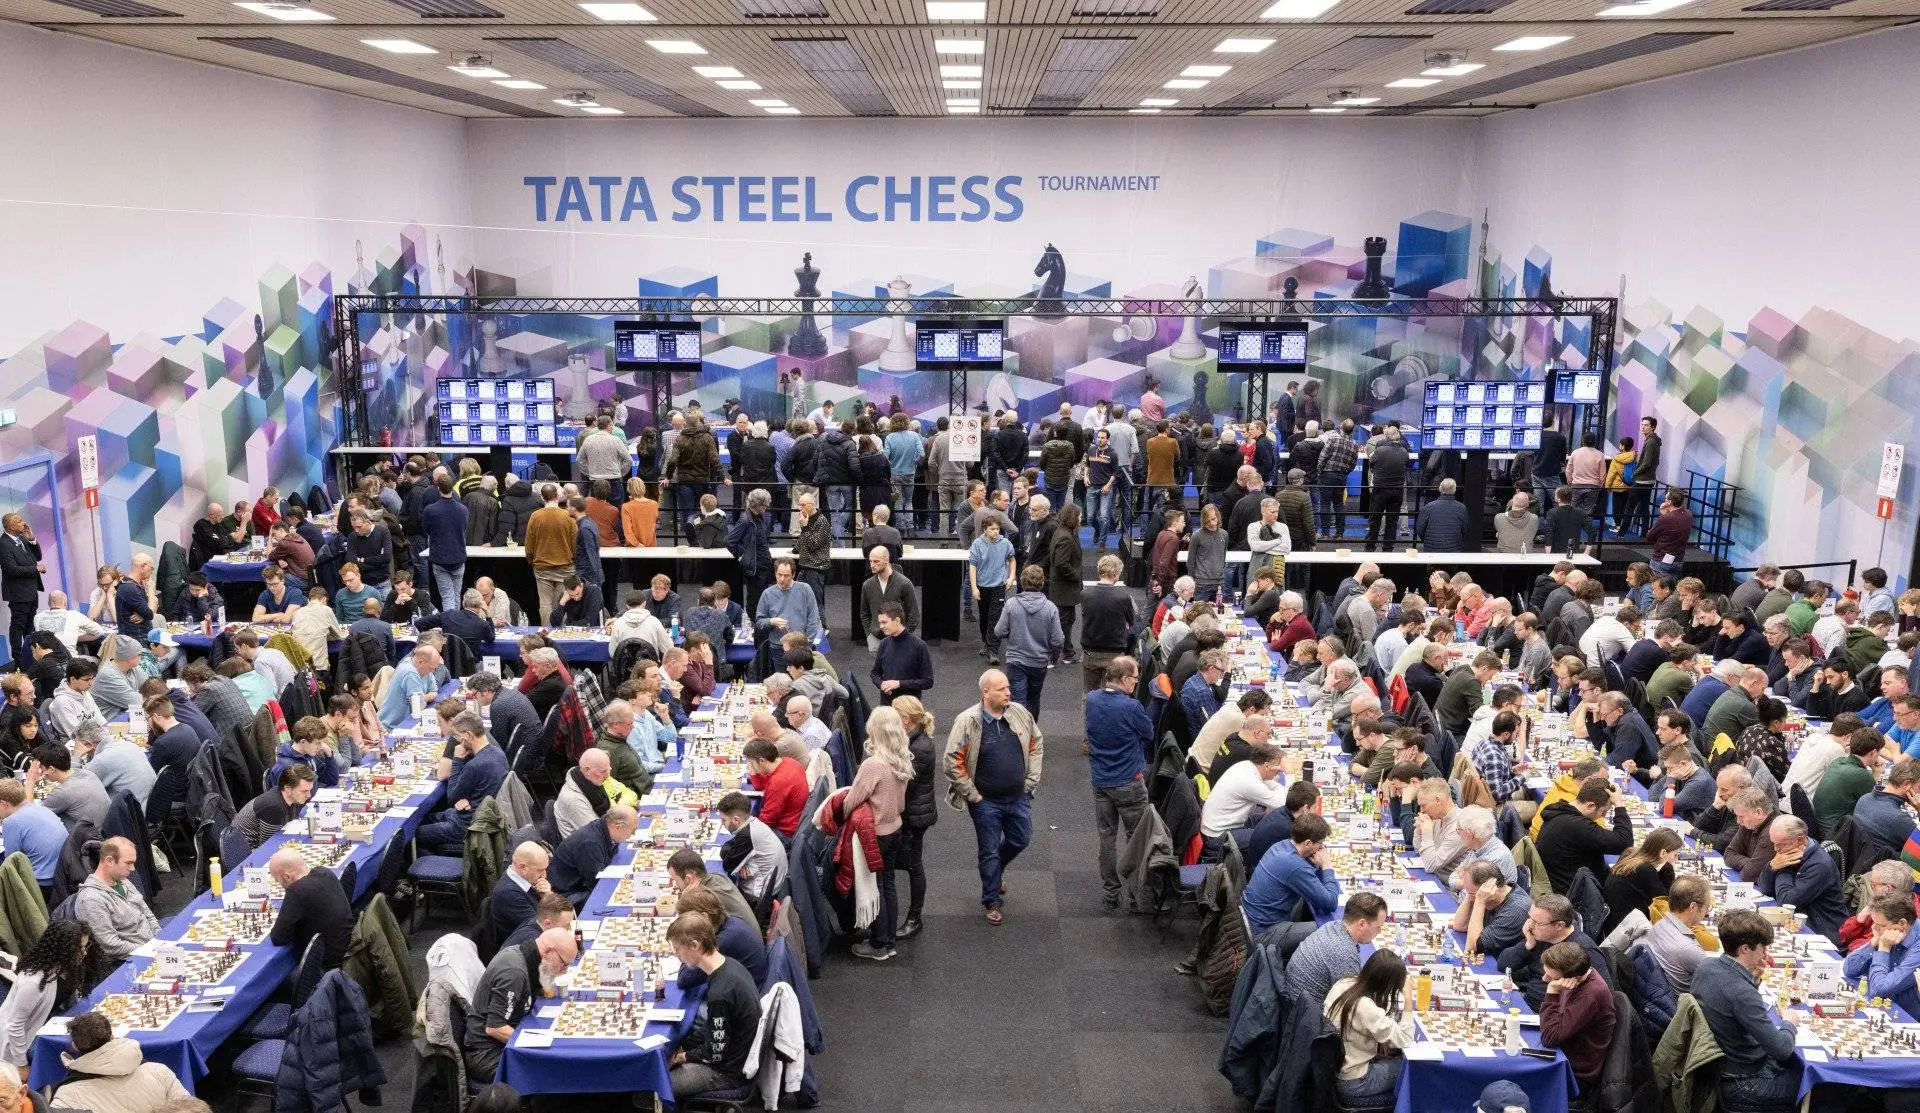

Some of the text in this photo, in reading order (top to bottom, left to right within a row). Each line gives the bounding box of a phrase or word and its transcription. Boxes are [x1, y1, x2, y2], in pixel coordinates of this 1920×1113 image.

[524, 175, 1160, 222] TATA STEEL CHESS TOURNAMENT
[165, 956, 178, 964] 5N
[607, 961, 621, 969] 5M
[1431, 974, 1445, 982] 4M
